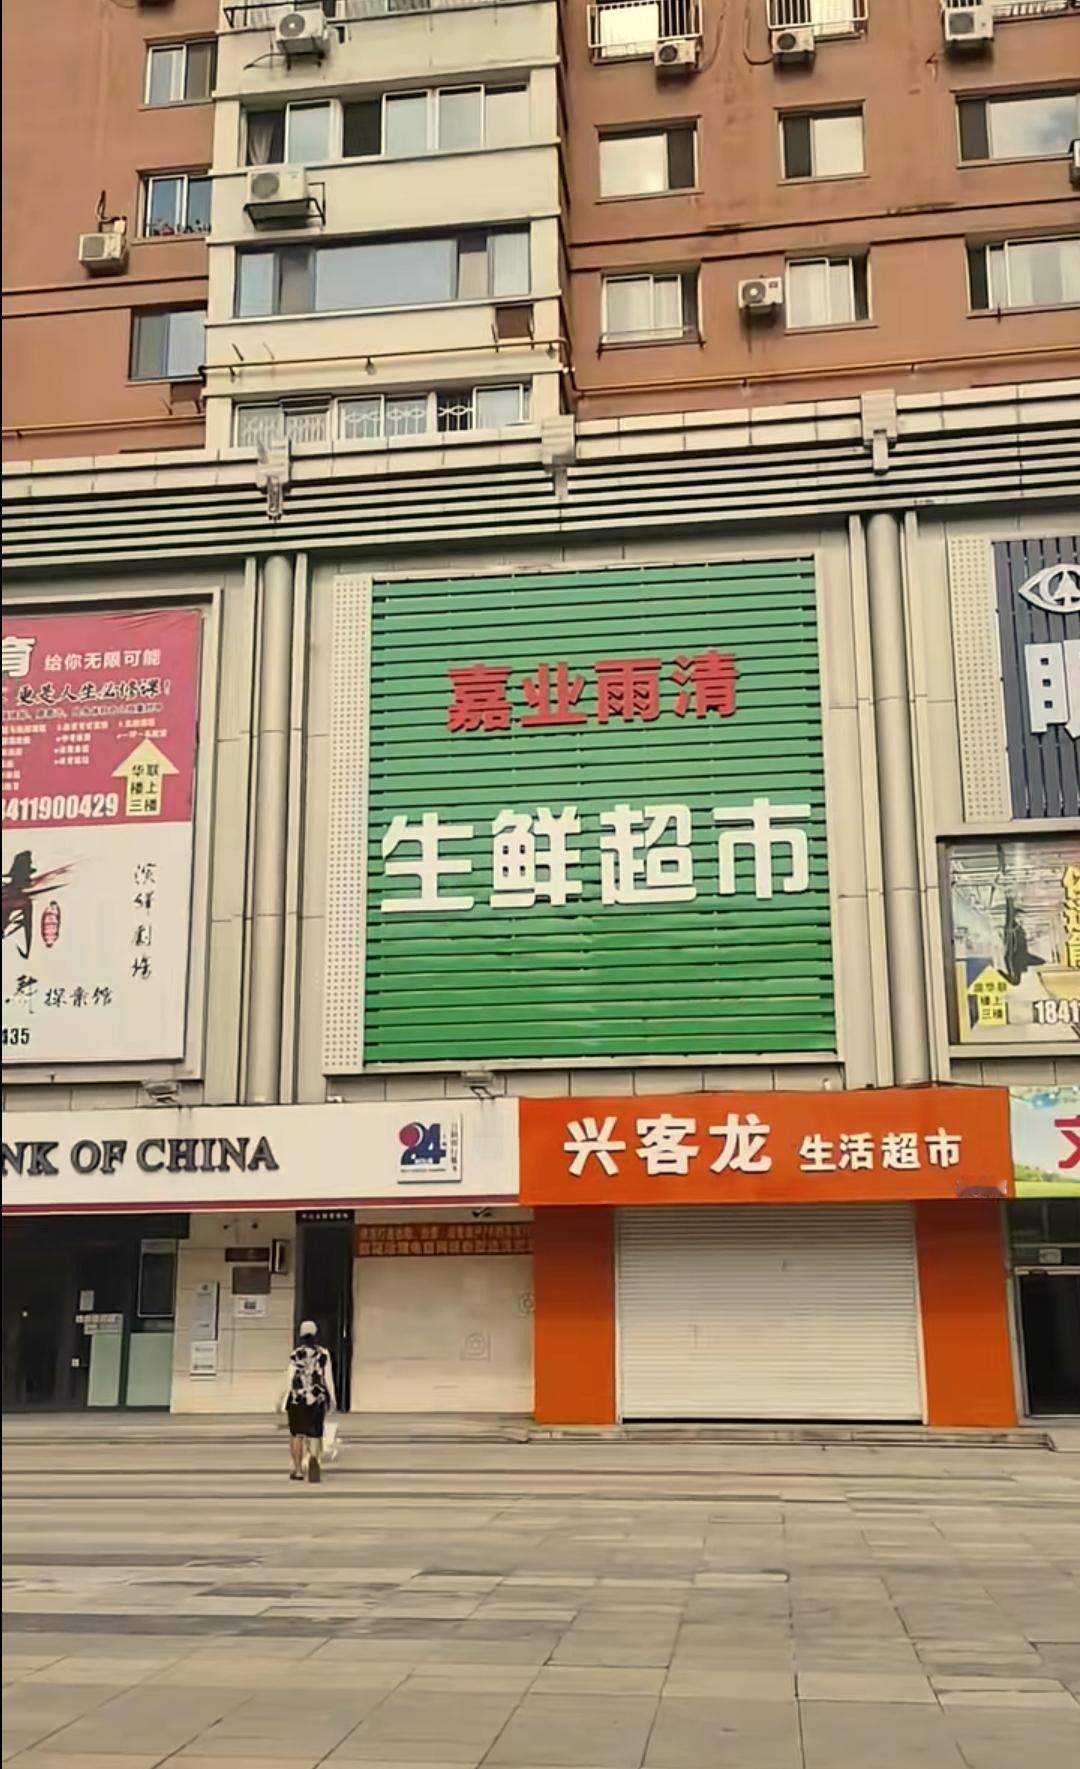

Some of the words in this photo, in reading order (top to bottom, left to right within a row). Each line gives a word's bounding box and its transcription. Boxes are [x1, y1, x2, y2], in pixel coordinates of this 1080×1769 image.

[44, 649, 161, 671] 给你无限可能
[447, 649, 738, 732] 嘉业雨清
[2, 792, 119, 821] 411900429
[381, 797, 811, 912] 生鲜超市
[1034, 1000, 1080, 1024] 1841
[70, 1139, 127, 1174] OF
[136, 1136, 280, 1172] CHINA
[399, 1121, 446, 1166] 24
[563, 1113, 772, 1175] 兴客龙
[799, 1127, 963, 1171] 生活超市
